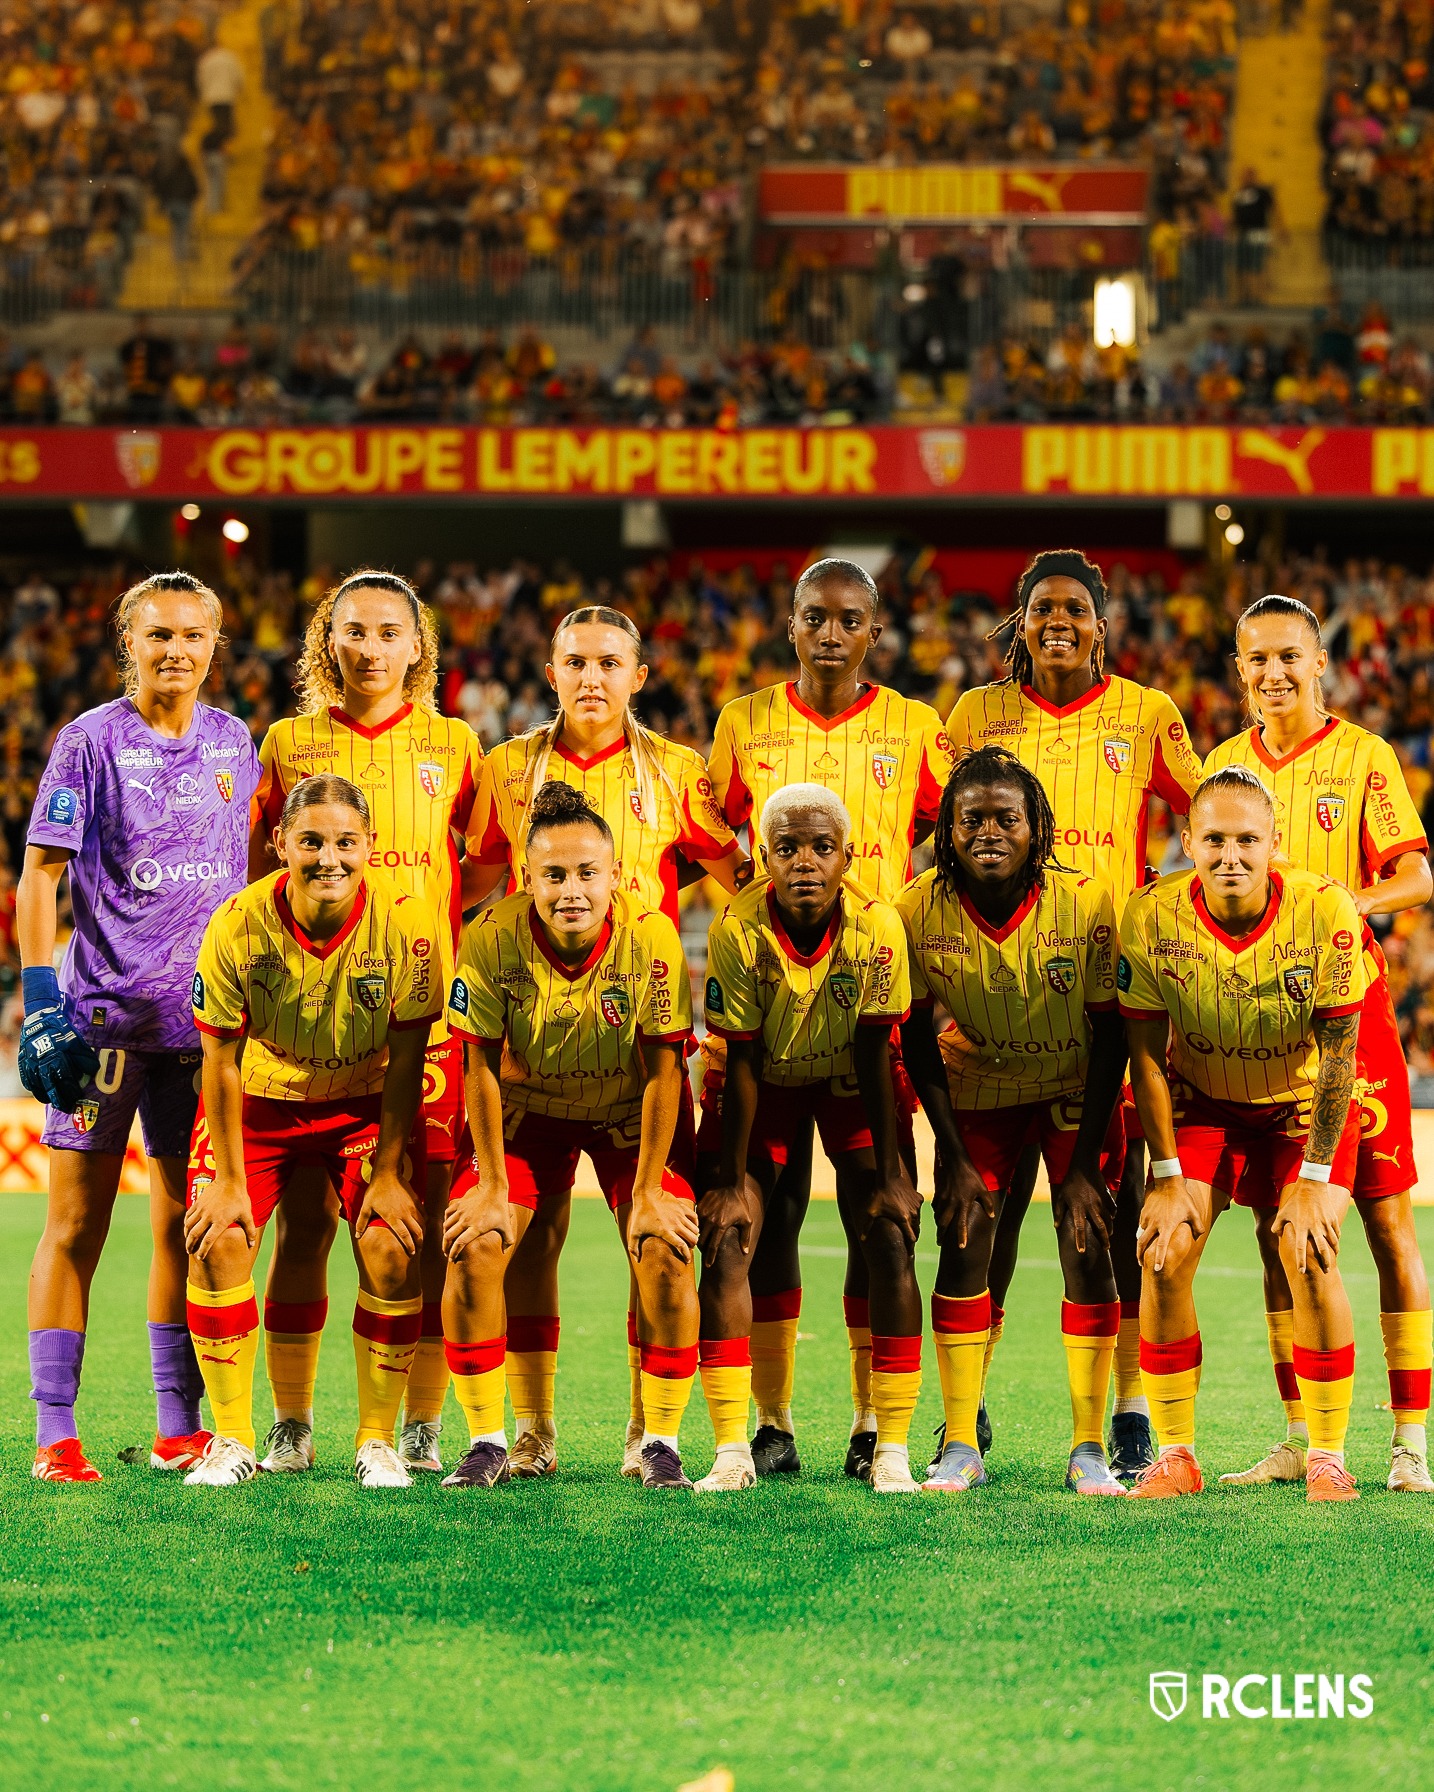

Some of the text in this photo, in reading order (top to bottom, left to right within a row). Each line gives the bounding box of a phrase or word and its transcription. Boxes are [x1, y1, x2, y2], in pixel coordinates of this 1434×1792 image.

[845, 169, 1003, 217] PUMA
[207, 430, 463, 492] GROUPE
[478, 430, 878, 492] LEMPEREUR
[1022, 427, 1233, 496] PUMA
[988, 719, 1021, 729] GROUPE
[1092, 715, 1145, 734] Nexans
[753, 730, 786, 742] GROUPE
[856, 728, 910, 747] Nexans
[978, 727, 1028, 738] LEMPEREUR
[201, 742, 240, 760] Nexans
[296, 742, 331, 753] GROUPE
[405, 737, 456, 756] Nexans
[743, 739, 795, 751] LEMPEREUR
[120, 749, 153, 758] GROUPE
[288, 750, 340, 763] LEMPEREUR
[116, 756, 164, 767] LEMPEREUR
[1042, 757, 1072, 765] NIEDAX
[811, 772, 840, 780] NIEDAX
[1304, 769, 1356, 786] Nexans
[175, 795, 203, 805] NIEDAX
[1053, 828, 1116, 848] EOLIA
[367, 850, 432, 868] EOLIA
[166, 860, 229, 883] VEOLIA
[926, 933, 962, 944] GROUPE
[1032, 929, 1087, 949] Nexans
[1159, 939, 1195, 951] GROUPE
[915, 942, 971, 955] LEMPEREUR
[1148, 947, 1204, 961] LEMPEREUR
[1269, 941, 1324, 961] Nexans
[345, 951, 397, 969] Nexans
[989, 985, 1020, 993] NIEDAX
[304, 1000, 333, 1008] NIEDAX
[991, 1037, 1082, 1054] VEOLIA
[1217, 1039, 1311, 1061] VEOLIA
[293, 1048, 378, 1070] VEOLIA
[536, 1066, 628, 1080] VEOLIA
